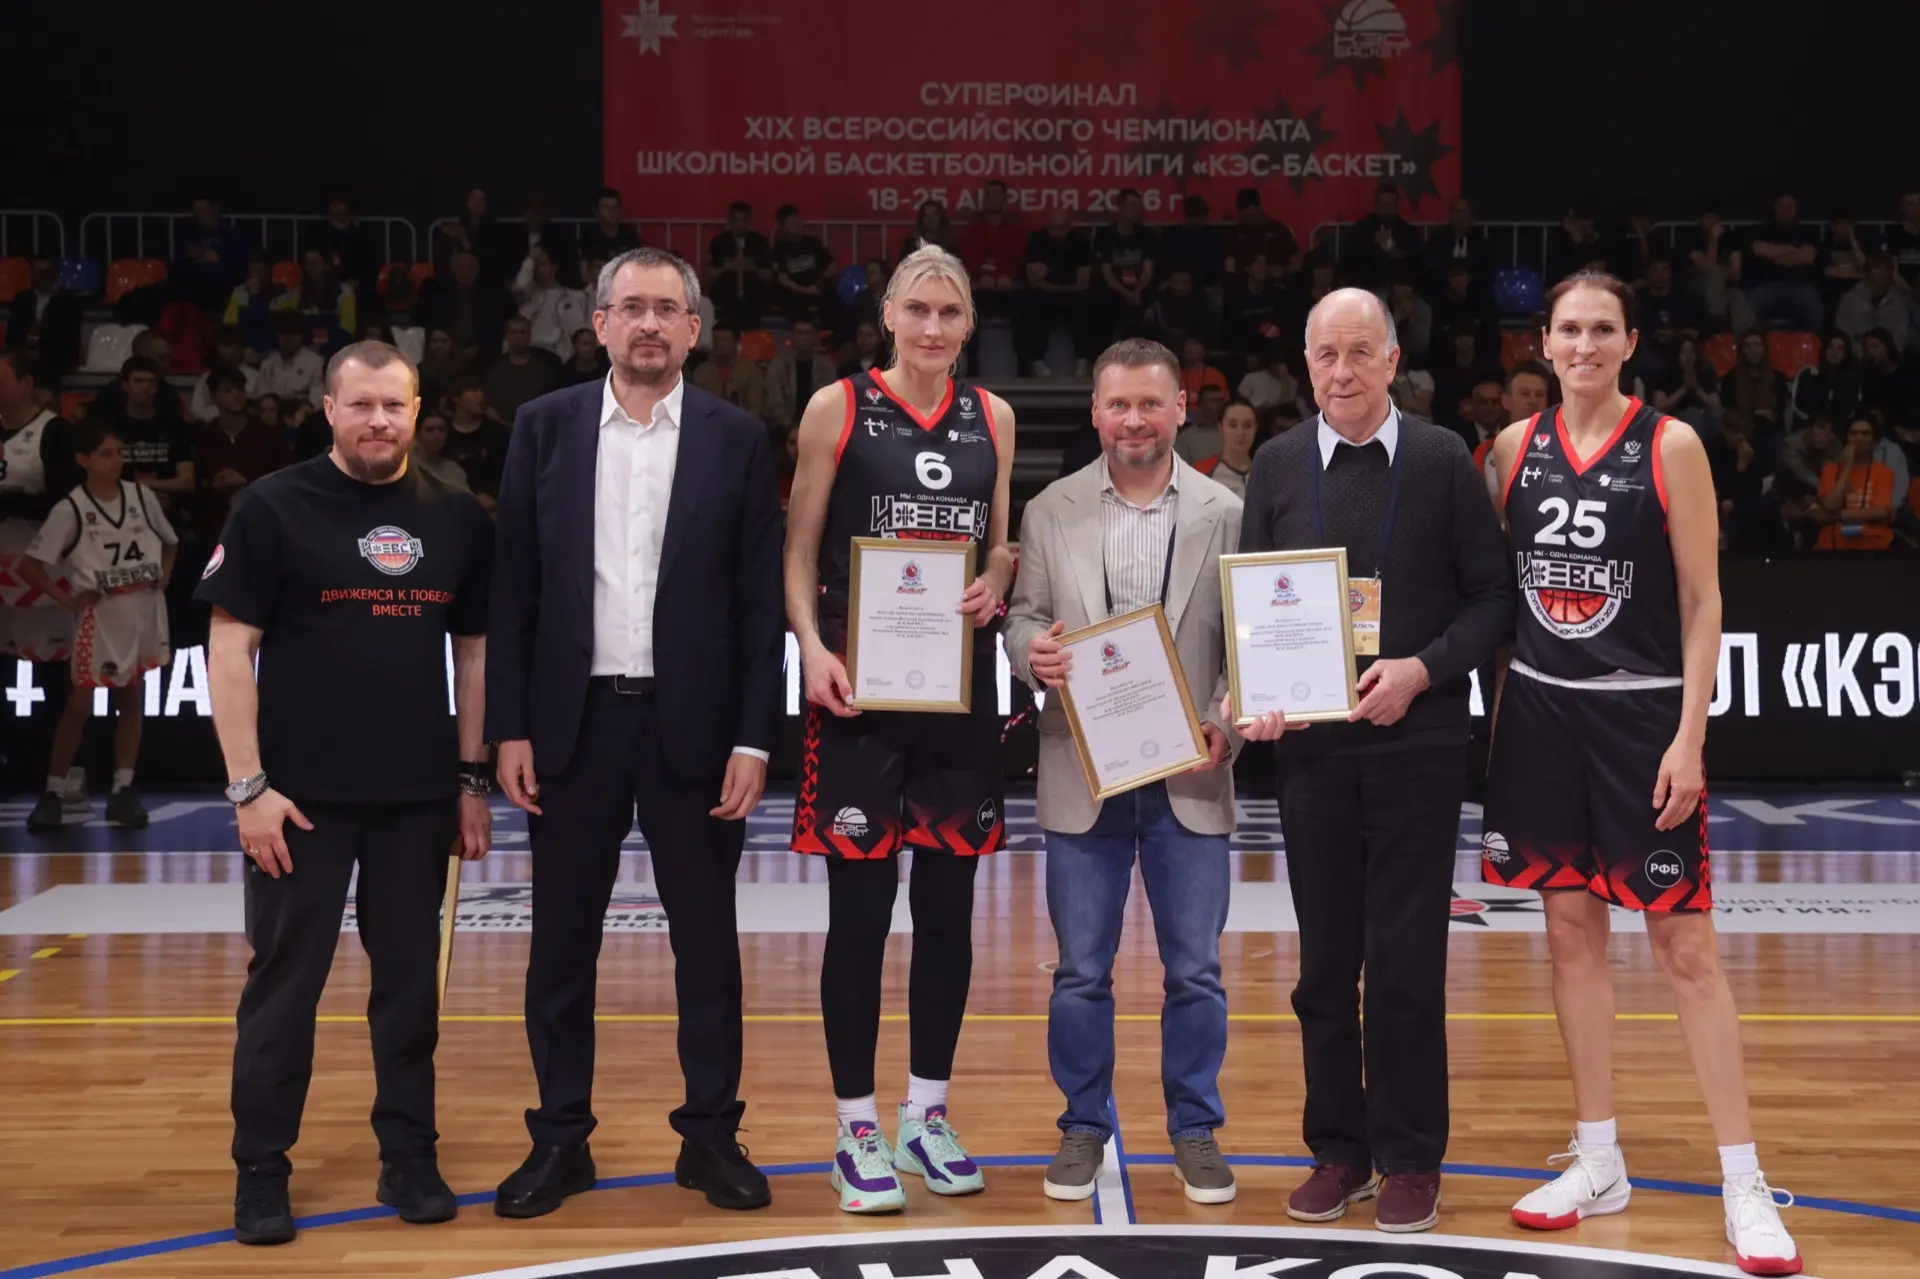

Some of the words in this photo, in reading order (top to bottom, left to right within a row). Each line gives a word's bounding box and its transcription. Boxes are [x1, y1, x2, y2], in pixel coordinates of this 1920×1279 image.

[920, 82, 1138, 107] СУПЕРФИНАЛ
[744, 117, 795, 140] XIX
[803, 113, 1095, 141] ВСЕРОССИЙСКОГО
[1101, 118, 1312, 142] ЧЕМПИОНАТА
[636, 147, 816, 175] ШКОЛЬНОЙ
[824, 148, 1094, 177] БАСКЕТБОЛЬНОЙ
[1100, 154, 1184, 176] ЛИГИ
[1192, 153, 1418, 177] «КЭС-БАСКЕТ»
[1086, 188, 1161, 212] 206
[915, 451, 953, 490] 6
[935, 496, 968, 504] КОМАНДА
[1534, 496, 1607, 549] 25
[104, 541, 145, 566] 74
[1549, 551, 1568, 559] ОДНА
[1569, 553, 1602, 563] КОМАНДА
[321, 588, 394, 604] ДВИЖЕМСЯ
[398, 589, 407, 601] К
[372, 604, 422, 617] ВМЕСТЕ
[1782, 632, 1920, 717] «КЭ
[1650, 863, 1680, 875] РФБ
